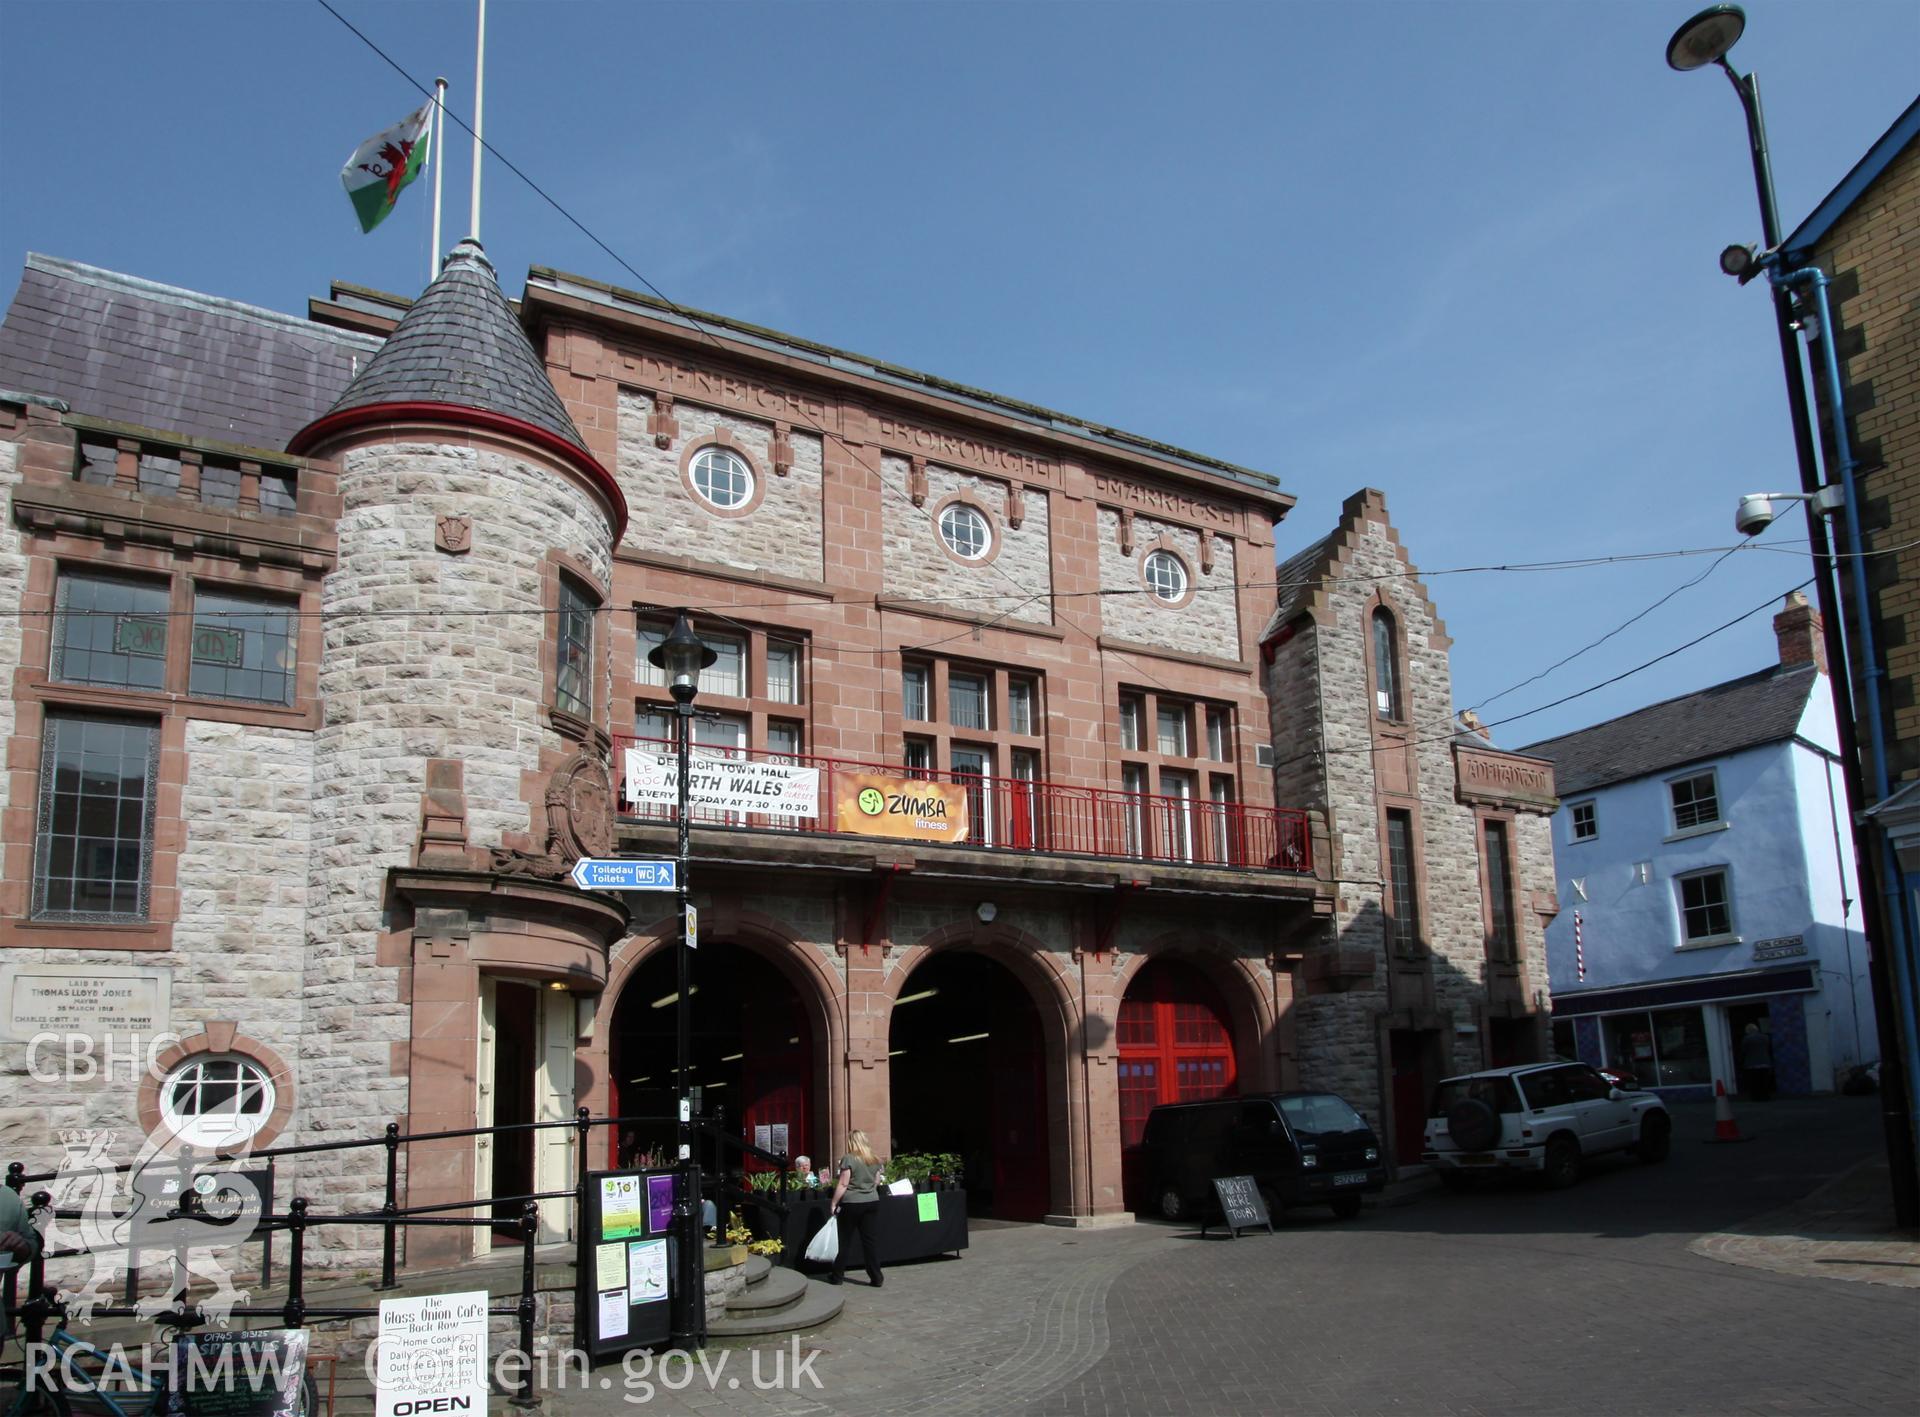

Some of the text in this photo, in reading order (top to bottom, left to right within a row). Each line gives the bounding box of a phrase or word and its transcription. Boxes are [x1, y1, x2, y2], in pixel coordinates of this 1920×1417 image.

[647, 355, 800, 416] DENBIGH
[898, 422, 1034, 476] BOROUGH
[1106, 478, 1219, 521] MARKETS
[720, 764, 755, 774] TOWN
[761, 768, 791, 779] HALL
[664, 772, 783, 797] NRTH WALES
[637, 789, 675, 799] EVERY
[680, 794, 727, 805] UESDAY
[730, 799, 744, 807] AT
[746, 800, 770, 809] 7.30
[779, 803, 809, 812] 10.30
[887, 794, 947, 818] ZUMBA
[915, 818, 948, 831] fitness
[592, 865, 633, 874] Toiledau
[638, 870, 653, 880] WC
[592, 874, 625, 883] Toilets
[31, 988, 70, 996] THOMAS
[71, 989, 98, 997] LLOYD
[1226, 1194, 1250, 1208] HERE
[1227, 1206, 1258, 1221] TODAY
[425, 1298, 443, 1308] The
[384, 1311, 416, 1325] Glass
[421, 1307, 451, 1322] Onion
[409, 1320, 460, 1333] Back Row
[203, 1331, 233, 1342] 01745
[402, 1338, 428, 1347] Home
[389, 1349, 412, 1361] Daily
[393, 1395, 471, 1417] OPEN
